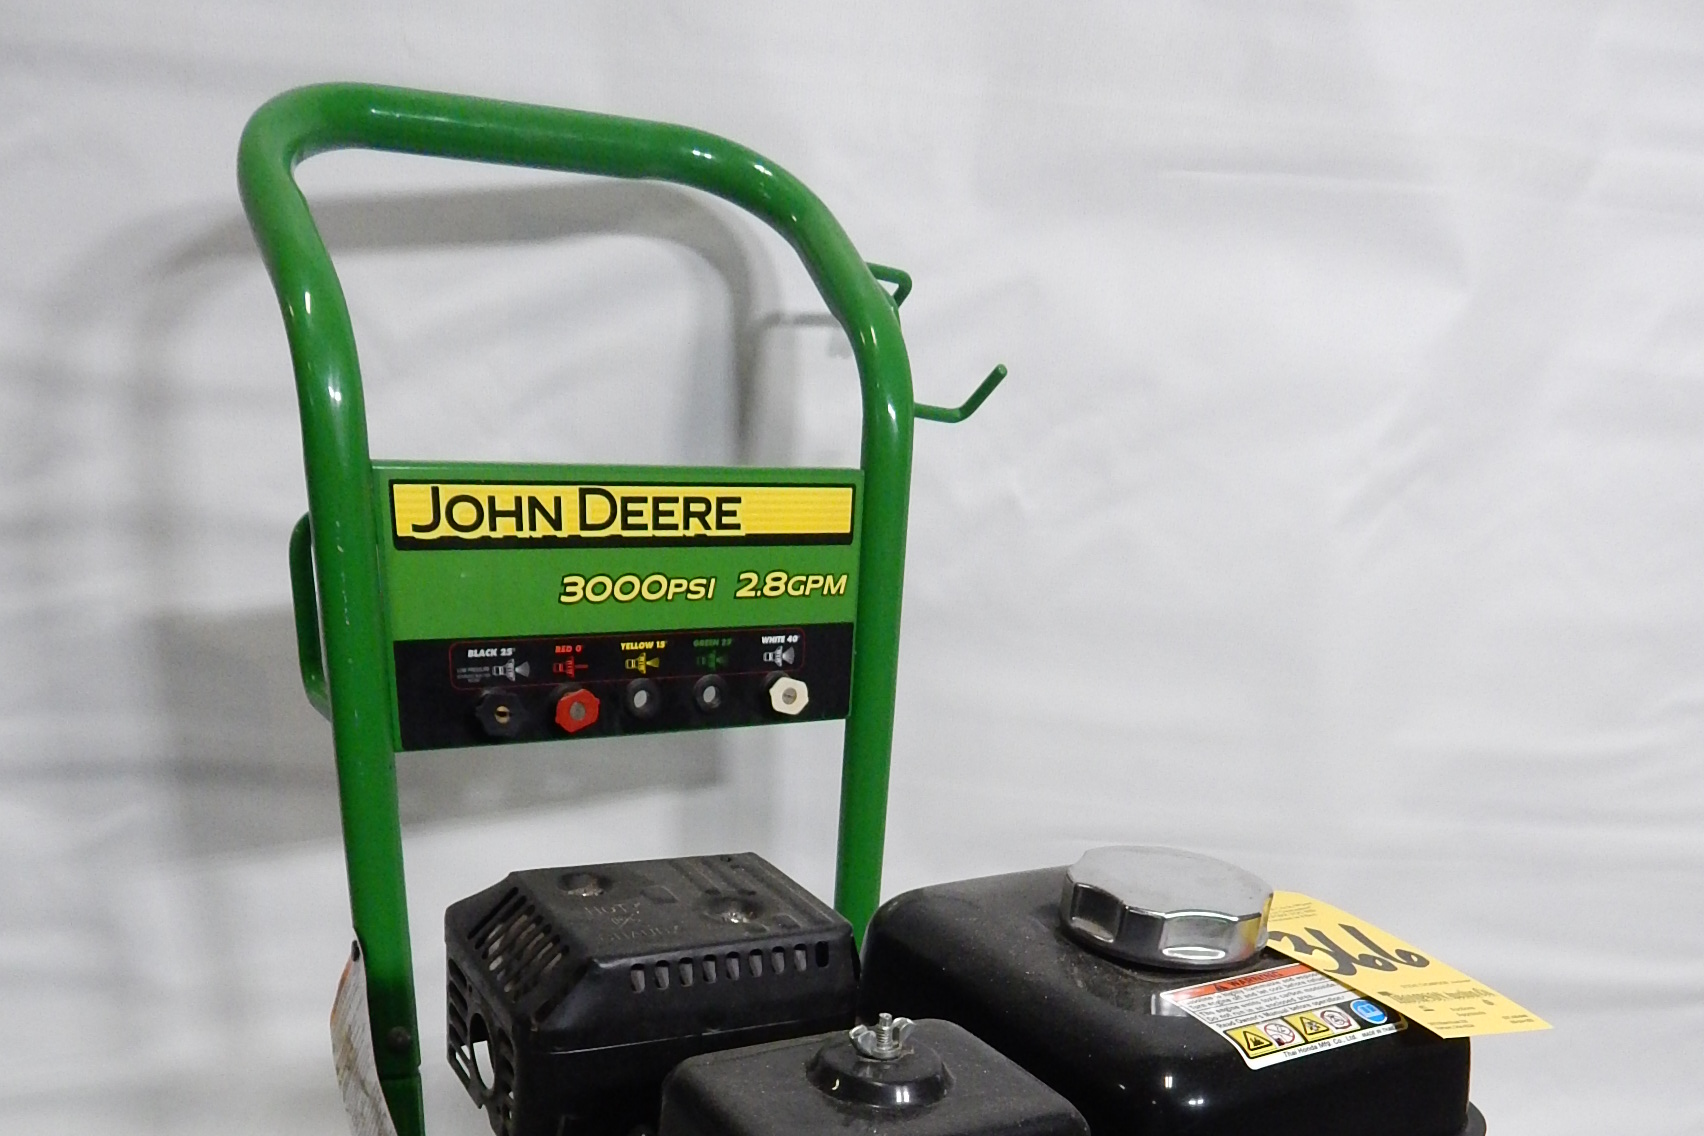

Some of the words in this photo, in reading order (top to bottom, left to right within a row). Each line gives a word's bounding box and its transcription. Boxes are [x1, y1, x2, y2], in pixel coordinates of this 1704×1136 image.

[411, 486, 562, 533] JOHN
[578, 487, 742, 531] DEERE
[559, 573, 717, 603] 3000PSI
[735, 571, 848, 599] 2.8GPM
[693, 638, 719, 648] GREEN
[761, 635, 785, 644] WHITE
[555, 645, 573, 653] RED
[620, 641, 654, 650] YELLOW
[468, 648, 497, 658] BLACK
[1268, 923, 1430, 976] 366
[1283, 1049, 1297, 1058] Thai
[1298, 1045, 1318, 1055] Honda
